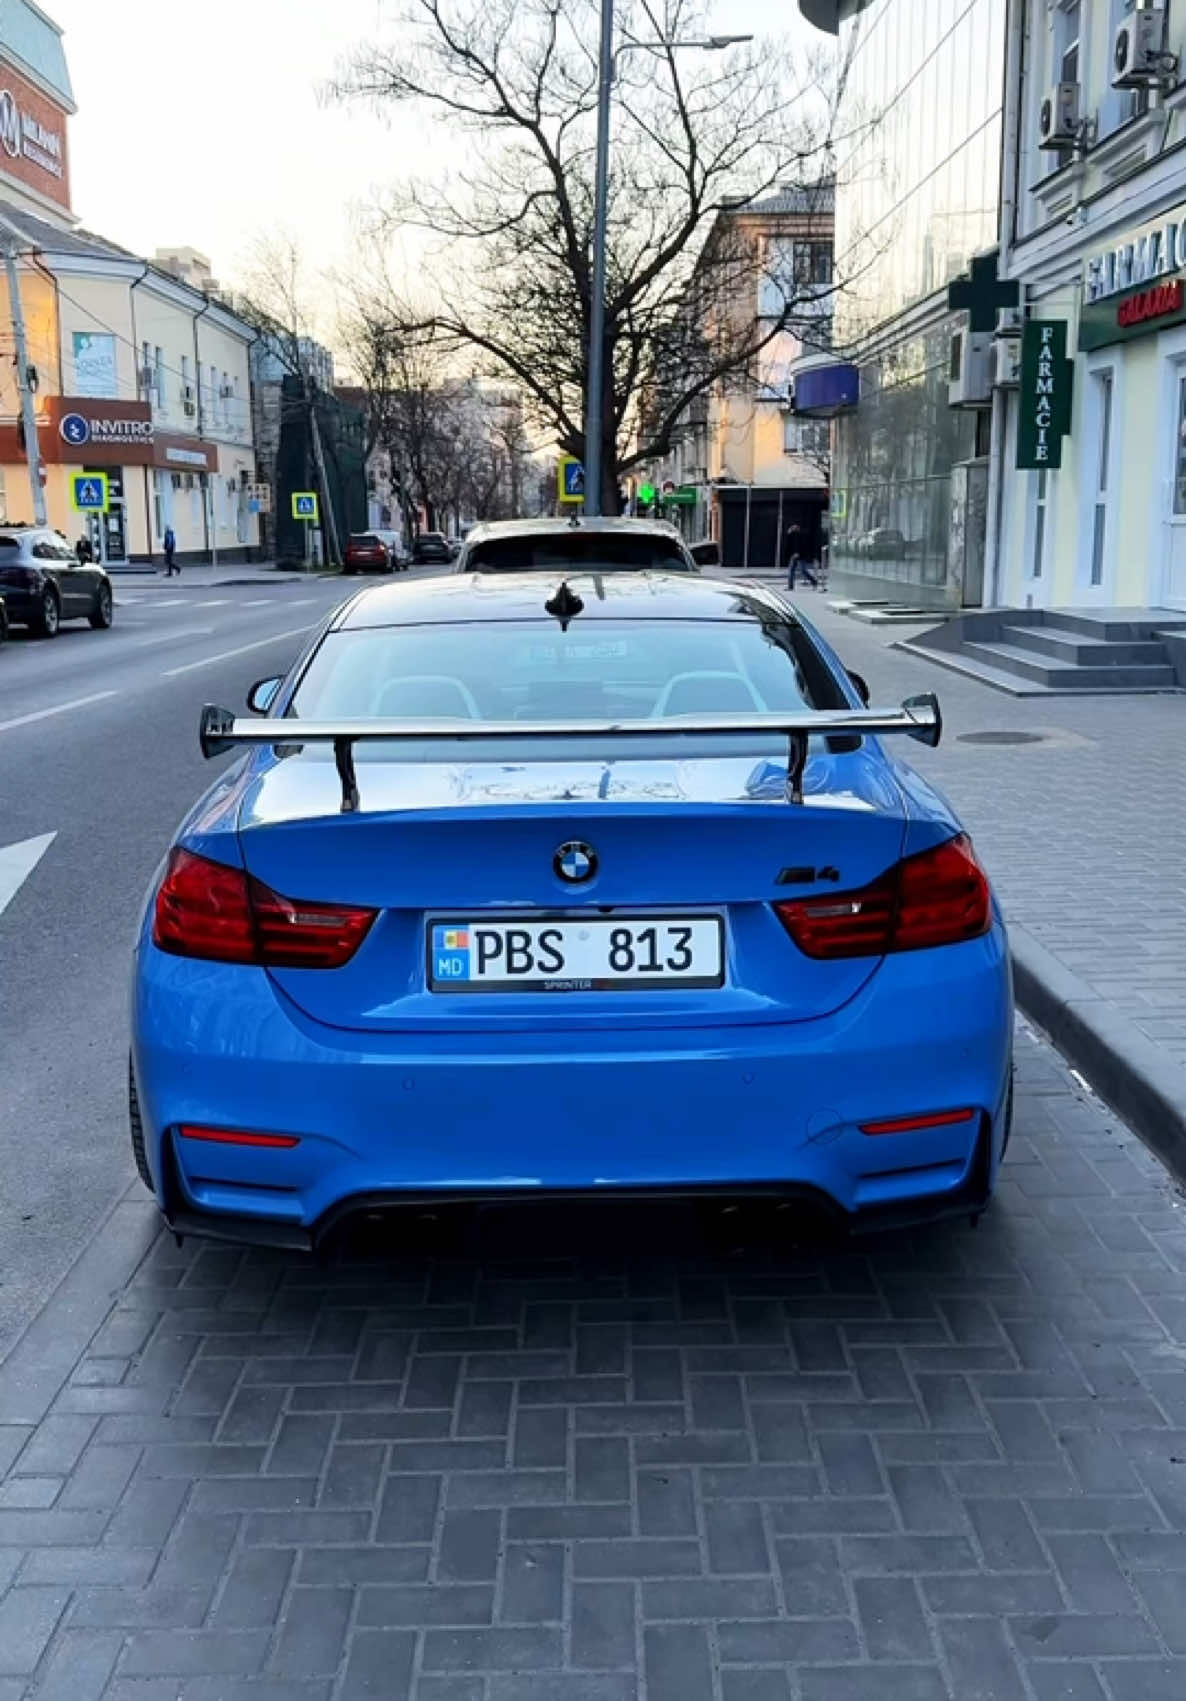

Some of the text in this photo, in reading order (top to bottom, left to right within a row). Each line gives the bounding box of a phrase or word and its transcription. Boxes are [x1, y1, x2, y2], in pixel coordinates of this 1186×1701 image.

[1034, 327, 1054, 460] FARMACIE
[90, 419, 154, 436] INVITRO
[438, 958, 464, 975] MD
[475, 927, 693, 975] PBS 813
